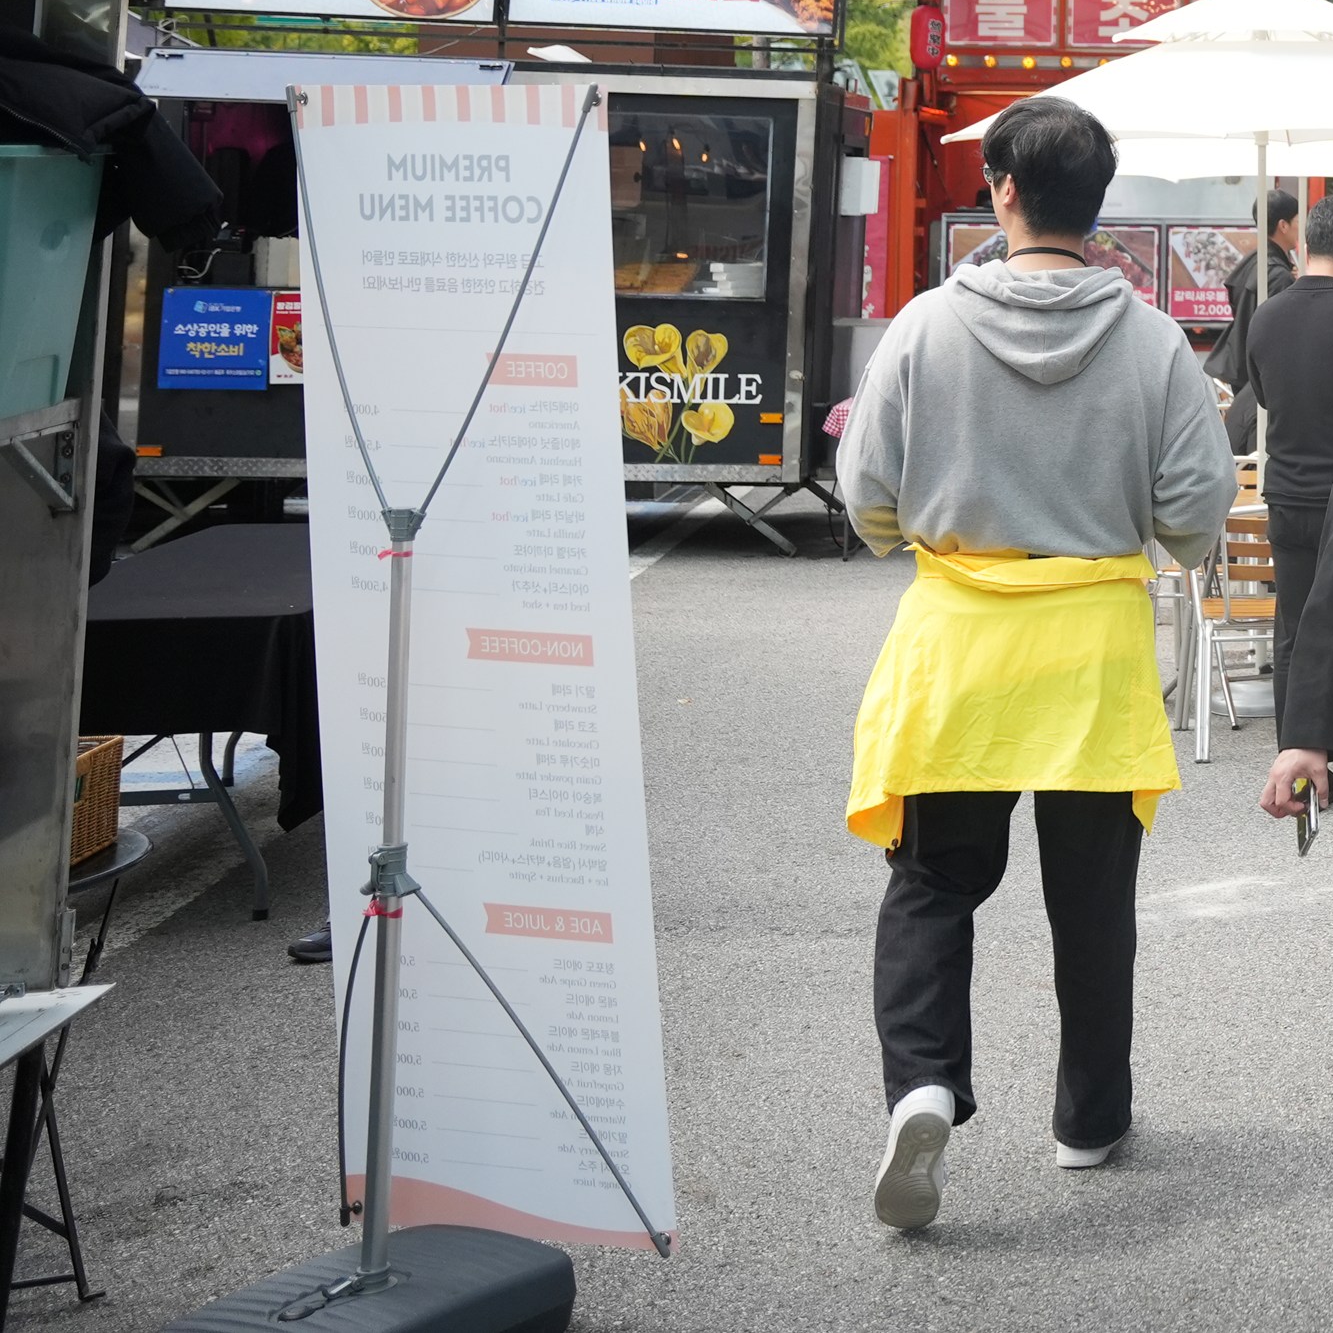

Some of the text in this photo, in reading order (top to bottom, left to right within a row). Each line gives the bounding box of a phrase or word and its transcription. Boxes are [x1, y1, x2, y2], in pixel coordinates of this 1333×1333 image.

[174, 323, 259, 337] 소상공인을 위한
[186, 342, 244, 358] 착한소비
